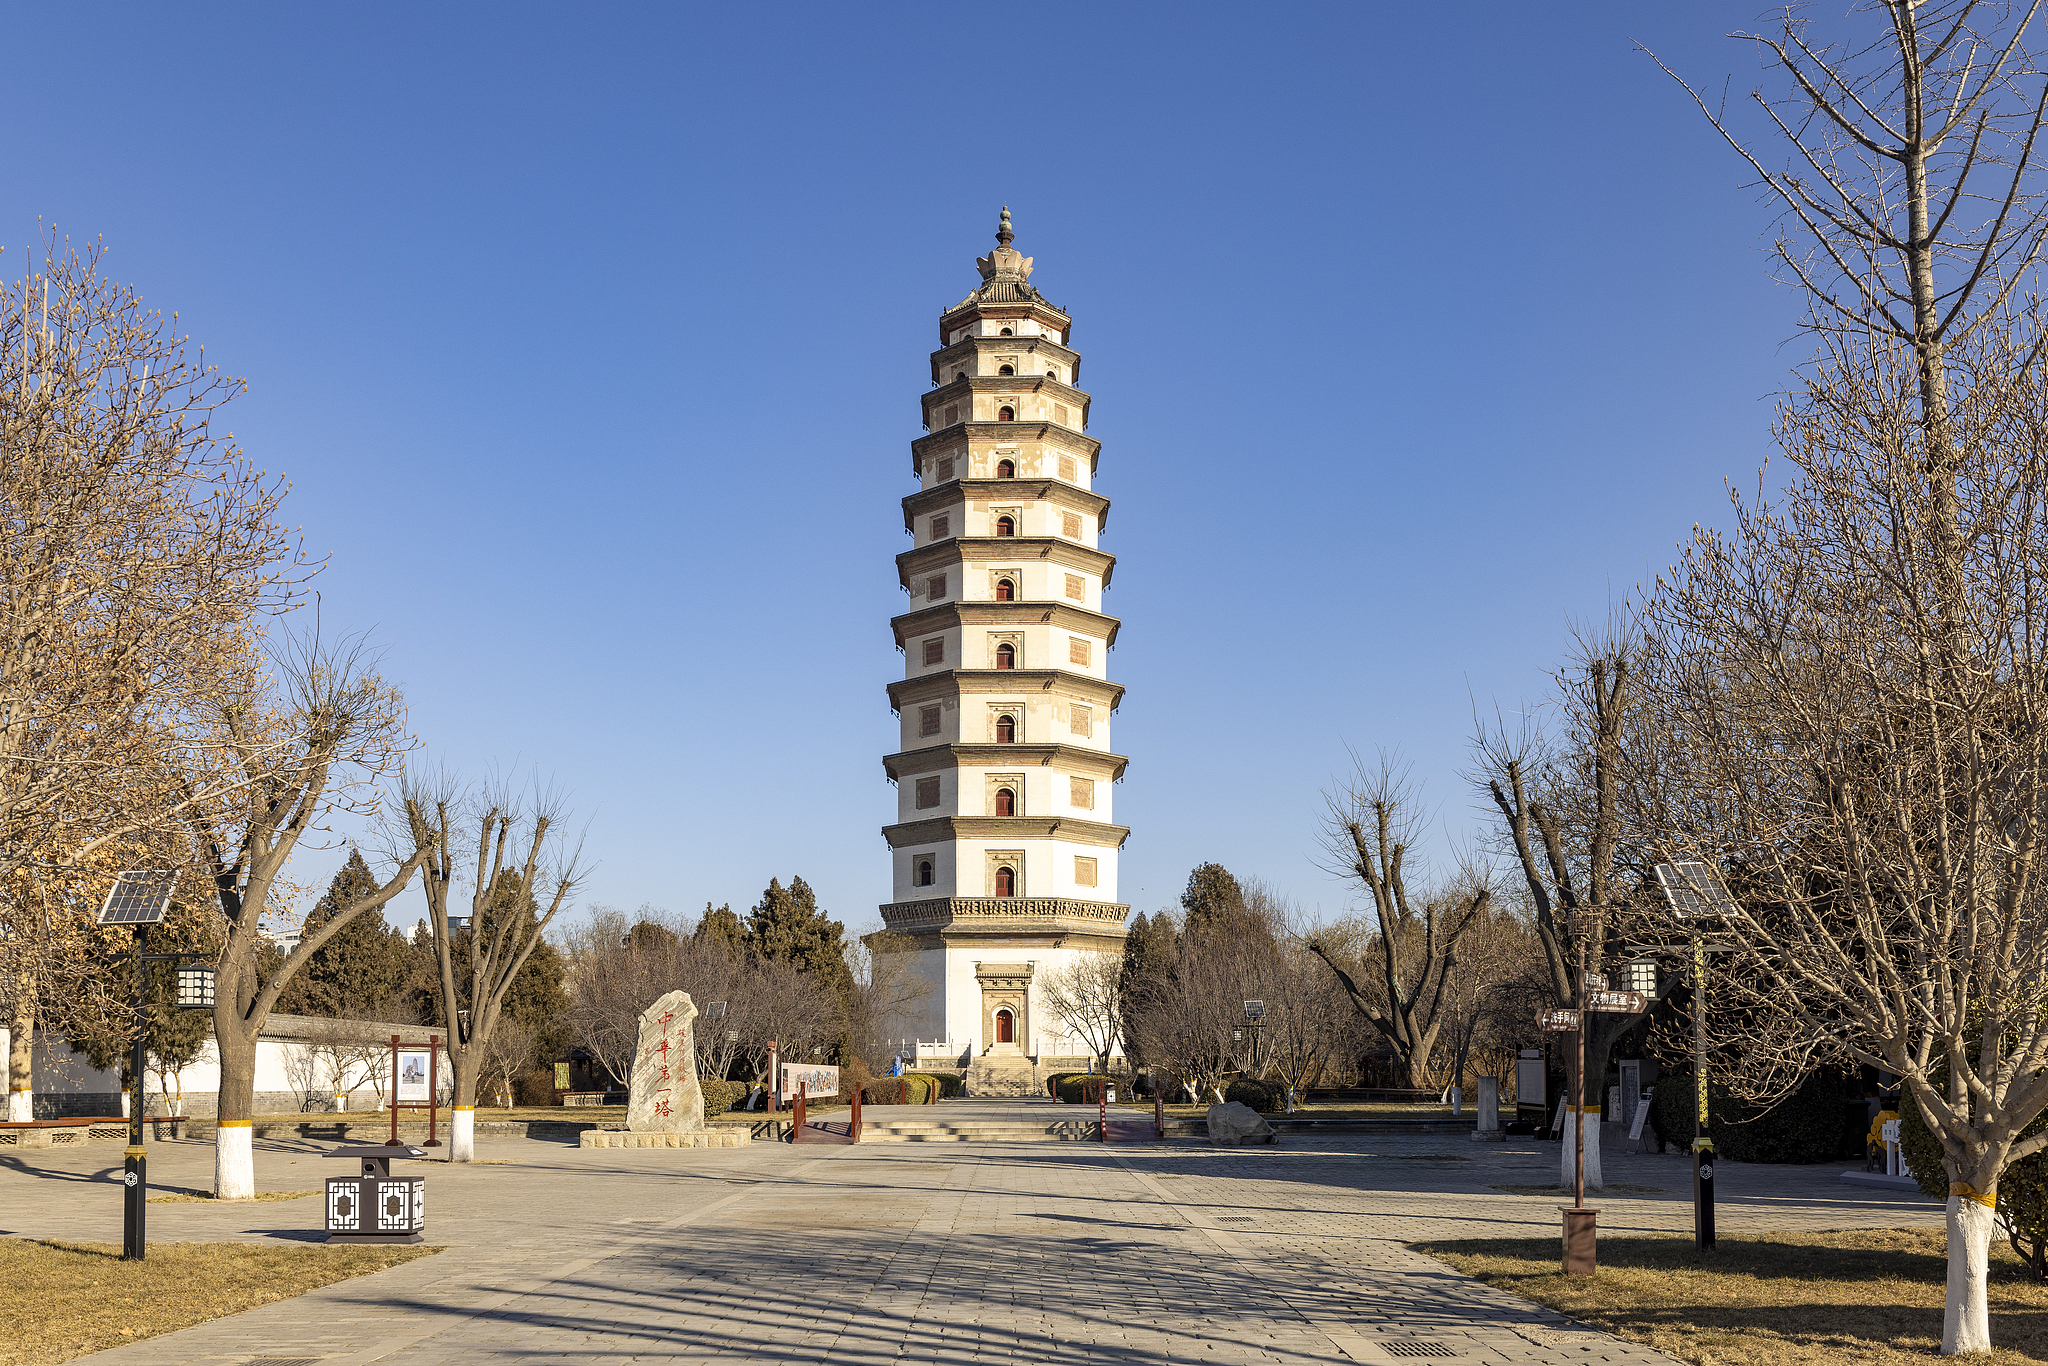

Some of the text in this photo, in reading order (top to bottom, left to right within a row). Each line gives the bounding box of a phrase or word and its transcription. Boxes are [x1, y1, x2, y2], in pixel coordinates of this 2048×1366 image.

[1590, 992, 1628, 1006] 文物展室
[1550, 1011, 1571, 1024] 洗手间
